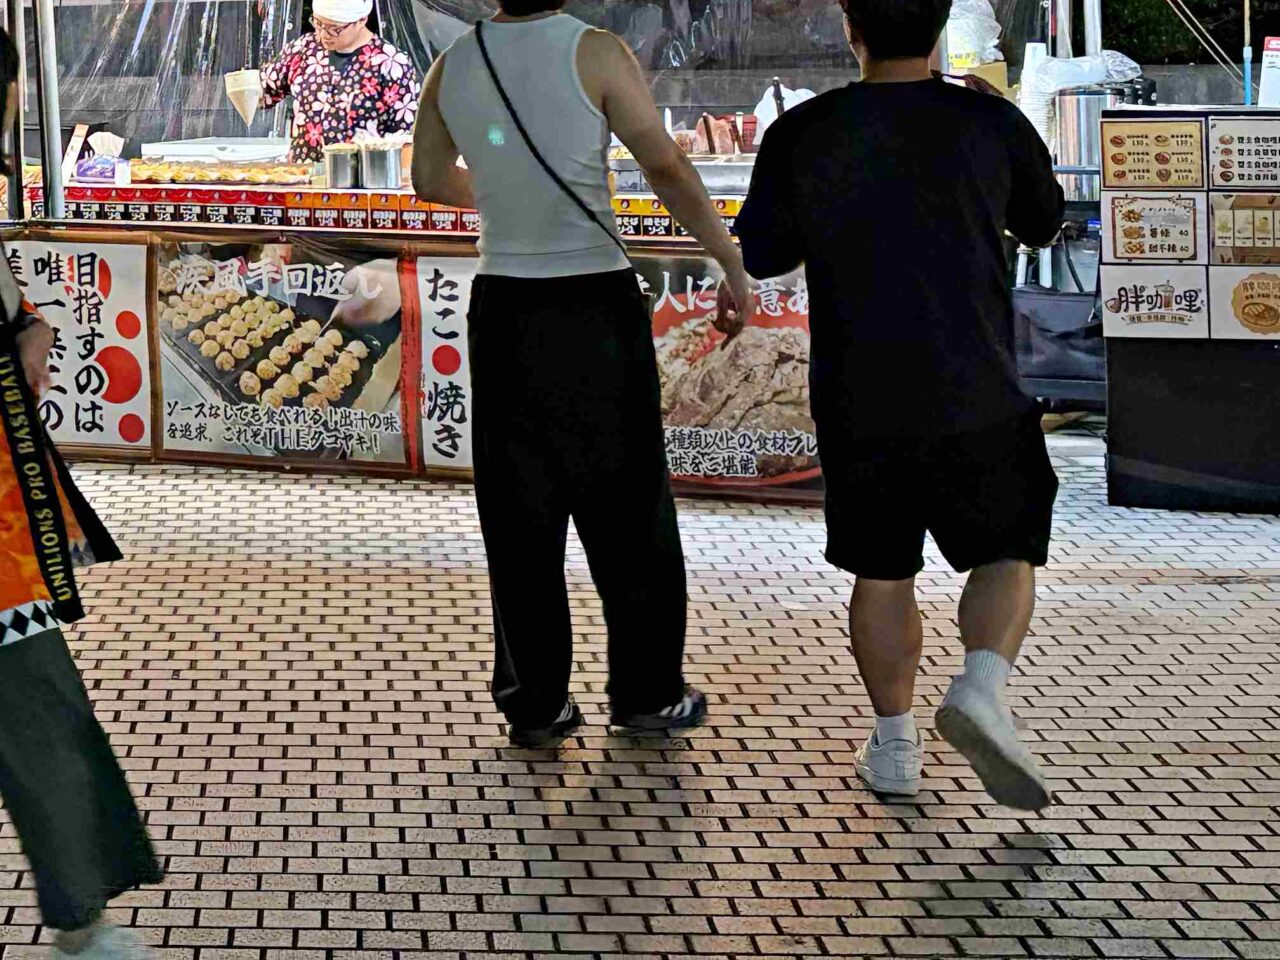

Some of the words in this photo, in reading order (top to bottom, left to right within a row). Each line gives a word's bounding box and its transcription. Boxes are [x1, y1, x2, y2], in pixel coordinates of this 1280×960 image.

[73, 251, 106, 433] 目指すのは
[33, 506, 73, 602] UNILIONS
